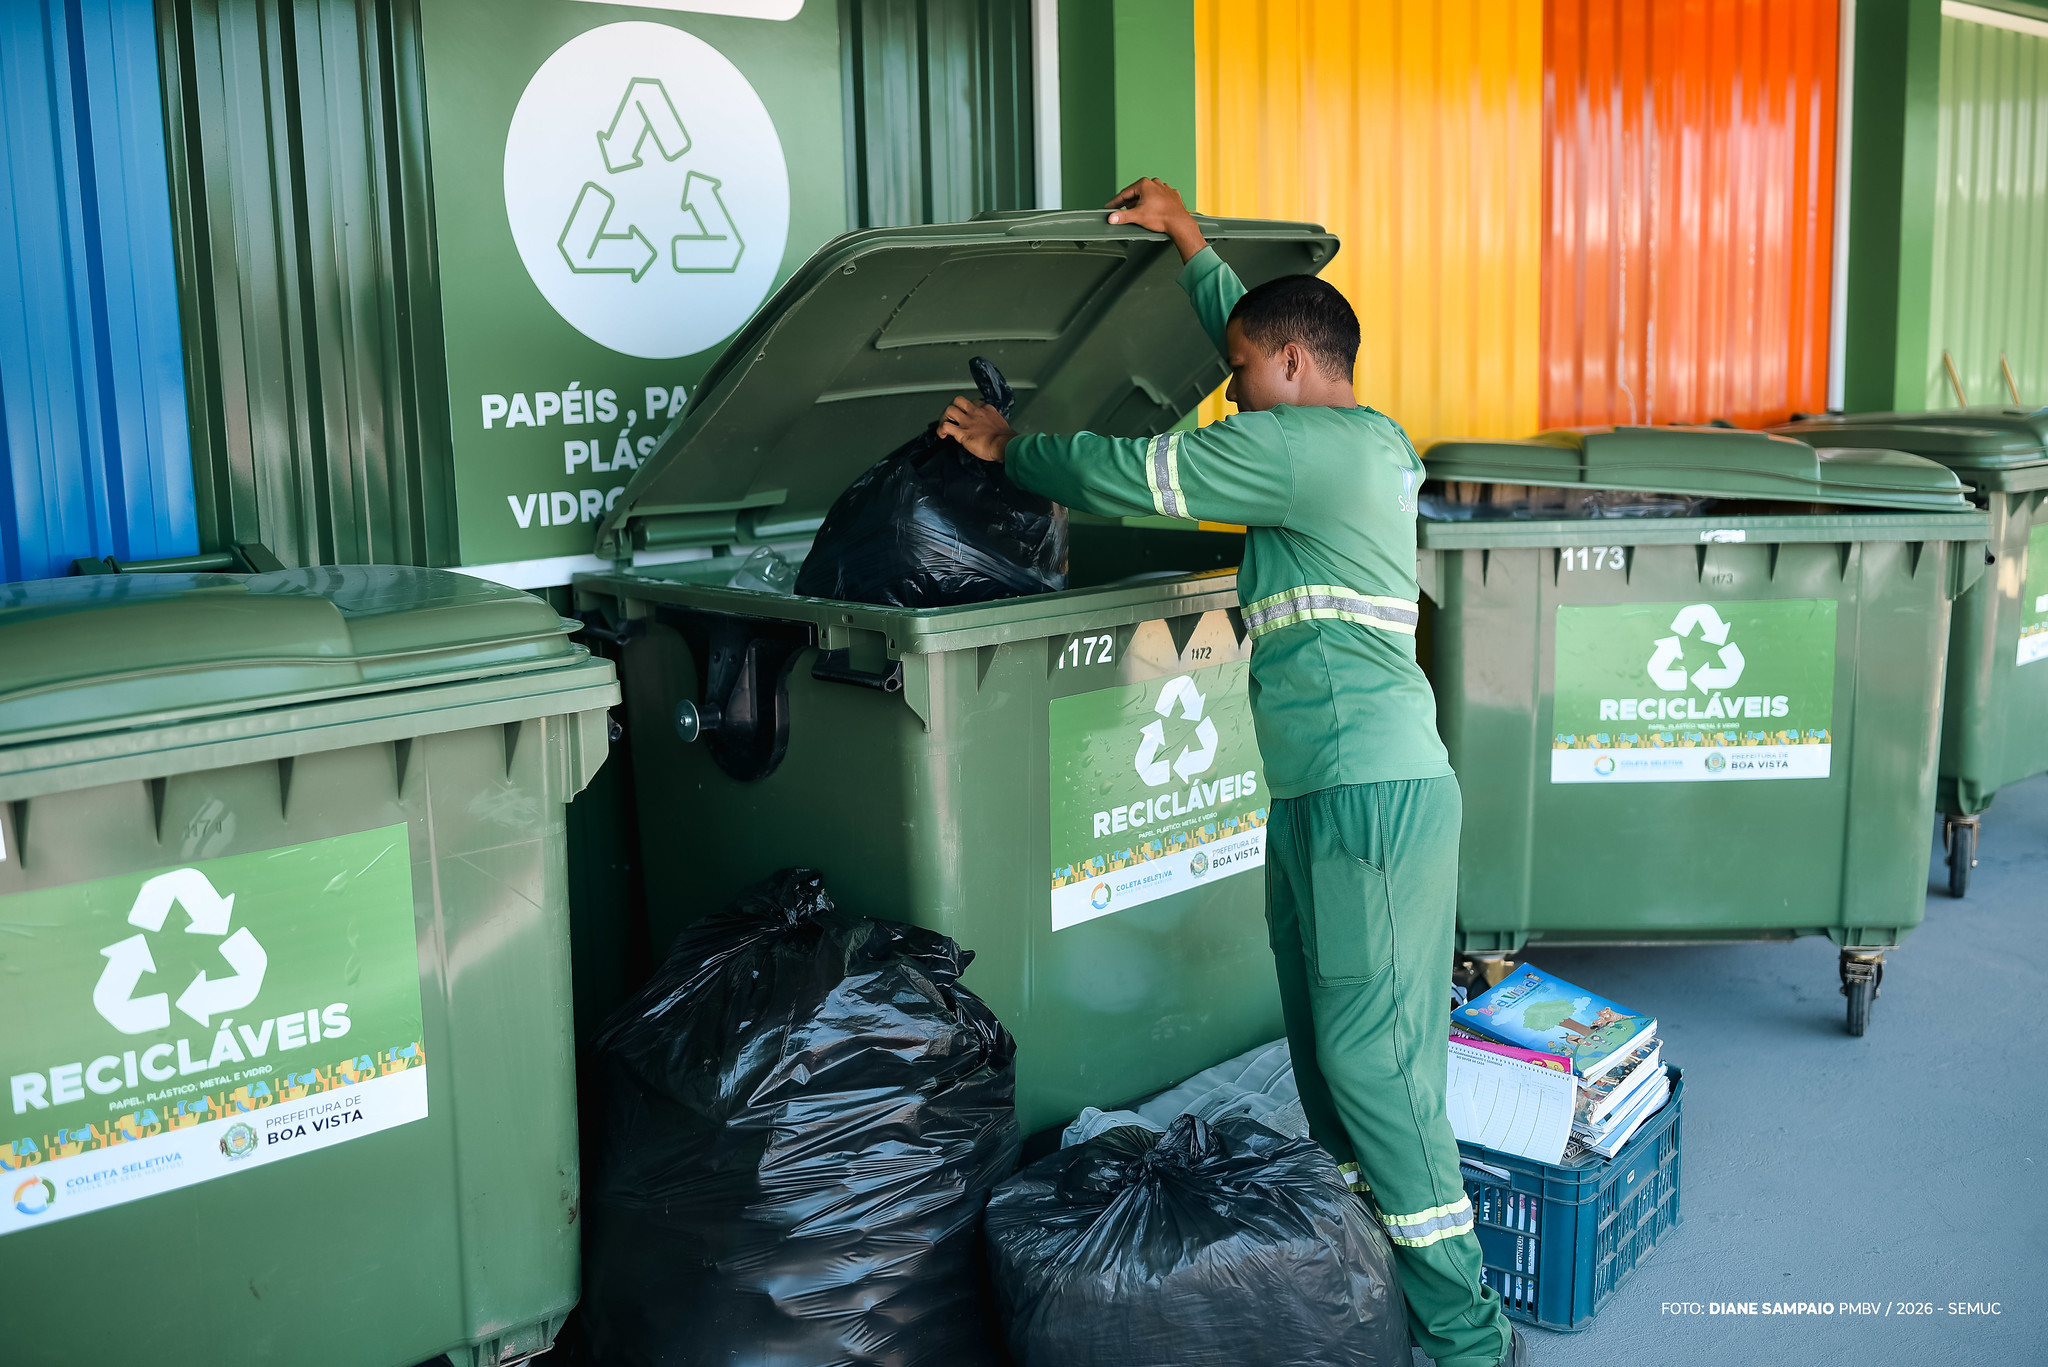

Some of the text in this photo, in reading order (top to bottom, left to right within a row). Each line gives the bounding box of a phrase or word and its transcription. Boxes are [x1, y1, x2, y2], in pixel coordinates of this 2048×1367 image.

[481, 381, 618, 430] PAPÉIS
[645, 385, 698, 420] PA
[564, 428, 661, 475] PLÁS
[1561, 546, 1625, 572] 1173
[1191, 647, 1212, 660] 1172
[1600, 691, 1789, 721] RECICLÁVEIS
[1731, 760, 1788, 770] BOA VISTA
[1093, 770, 1257, 839] RECICLÁVEIS
[1212, 836, 1260, 856] PREFEITURA DE
[1213, 847, 1260, 869] BOA VISTA
[1116, 879, 1142, 892] COLETA
[1143, 869, 1173, 885] SELETIVA
[10, 1002, 352, 1114] RECICLÁVEIS
[200, 1076, 233, 1091] METAL
[234, 1073, 242, 1085] E
[242, 1064, 273, 1081] VIDRO
[266, 1095, 362, 1129] PREFEITURA DE
[267, 1109, 364, 1145] BOA VISTA
[66, 1152, 183, 1189] COLETA SELETIVA
